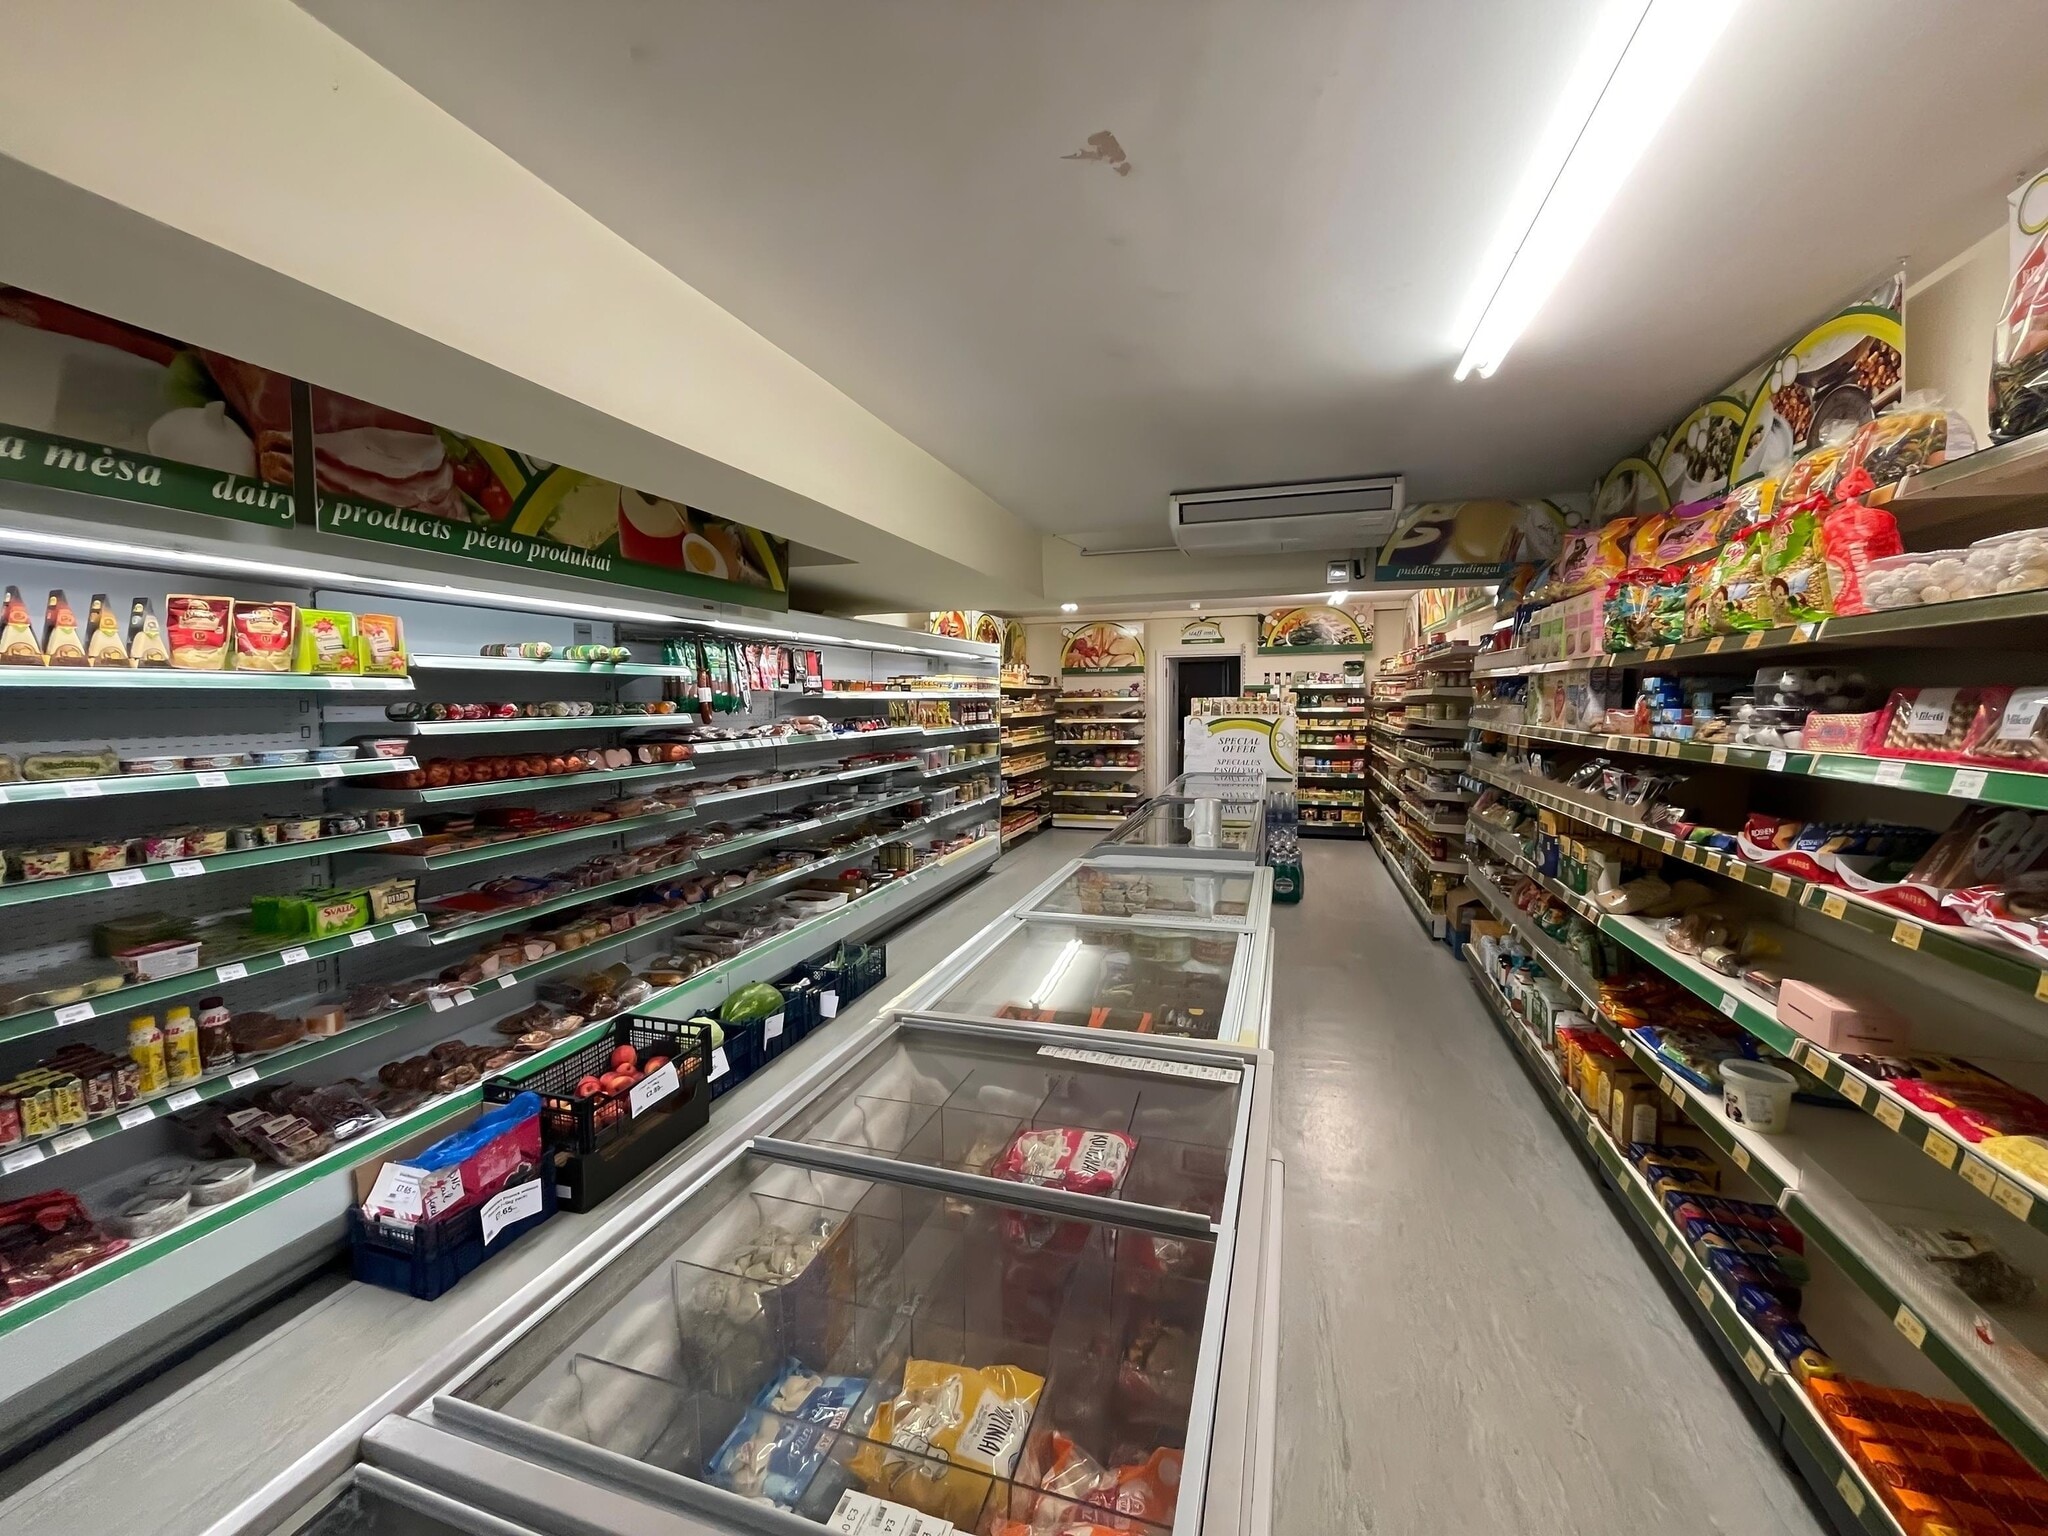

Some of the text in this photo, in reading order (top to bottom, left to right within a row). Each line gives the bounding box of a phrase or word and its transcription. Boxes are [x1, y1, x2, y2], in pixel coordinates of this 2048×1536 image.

[43, 445, 162, 487] mėsa
[212, 474, 612, 573] dairy products pieno produktai
[1396, 565, 1441, 578] pudding
[1451, 563, 1501, 577] pudingai
[1218, 737, 1260, 745] SPECIAL
[1222, 745, 1257, 753] OFFER
[1786, 857, 1810, 871] WAFERS
[1896, 890, 1928, 908] WAFERS
[323, 903, 357, 918] SVALIA
